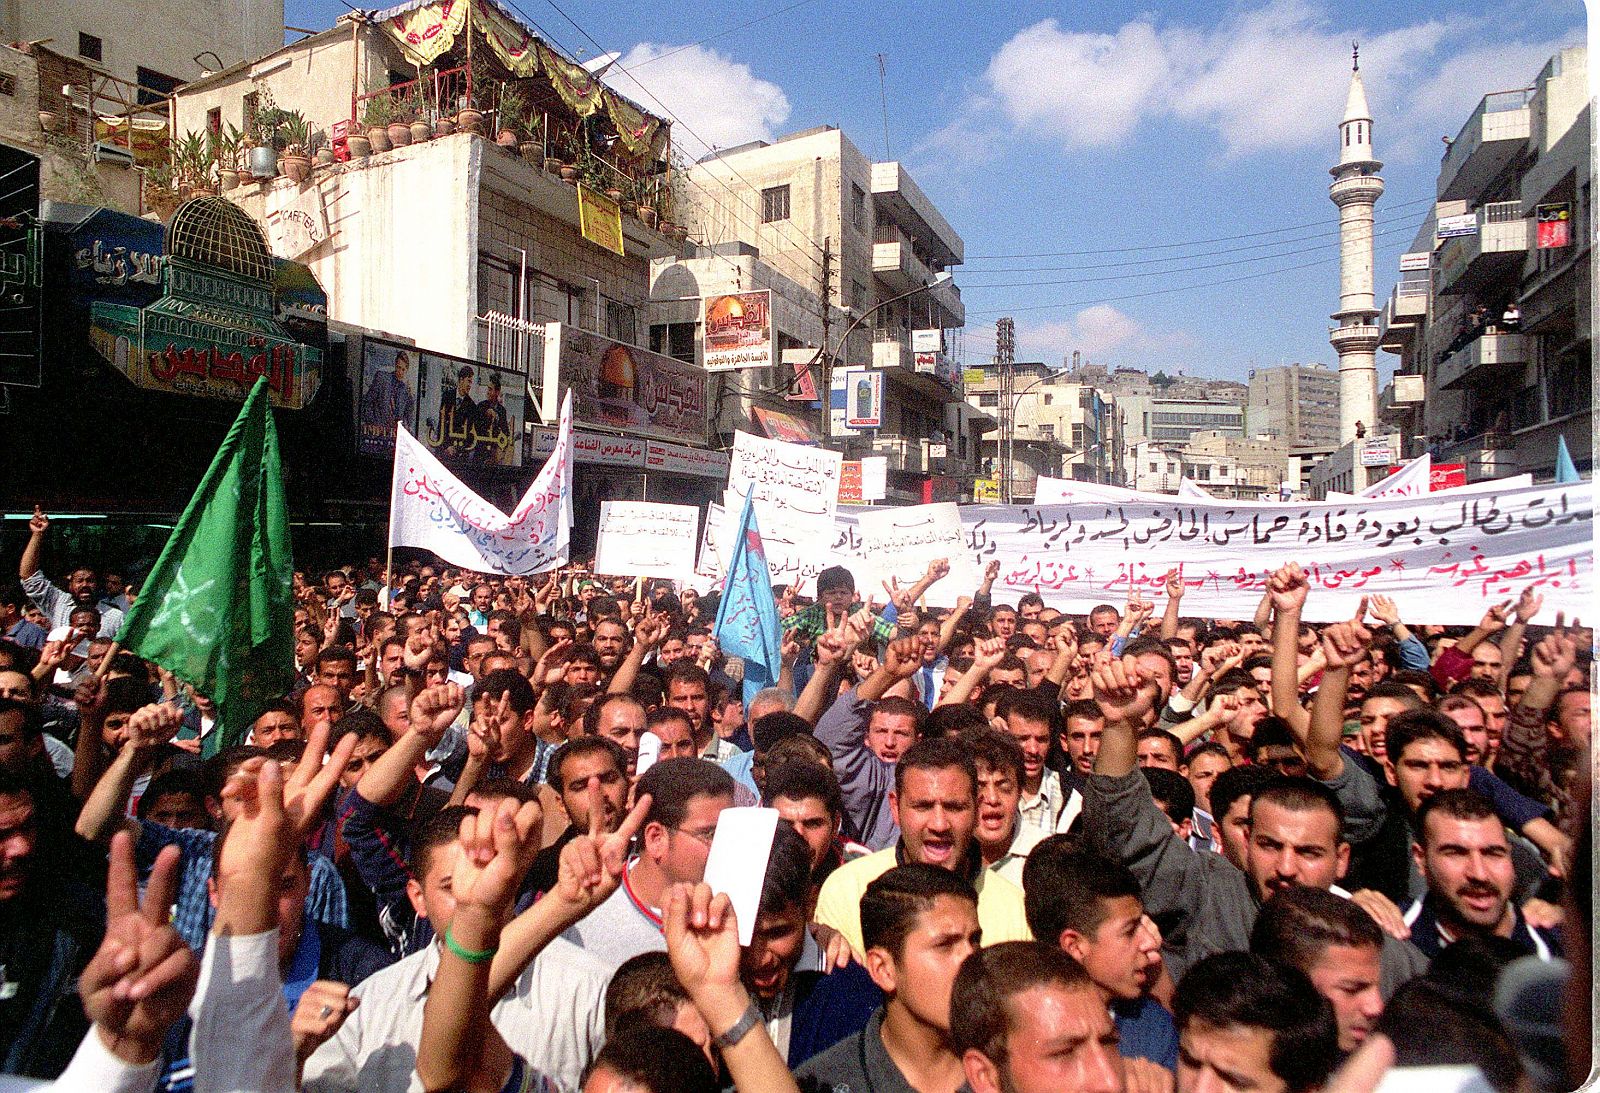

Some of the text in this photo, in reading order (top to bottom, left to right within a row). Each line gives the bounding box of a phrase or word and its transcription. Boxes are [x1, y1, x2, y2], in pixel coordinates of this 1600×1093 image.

[705, 301, 767, 335] القدس
[150, 335, 296, 400] القدس
[645, 372, 706, 418] القدس
[1213, 509, 1290, 546] حماس
[1297, 508, 1349, 545] قادة
[1354, 508, 1424, 548] بعودة
